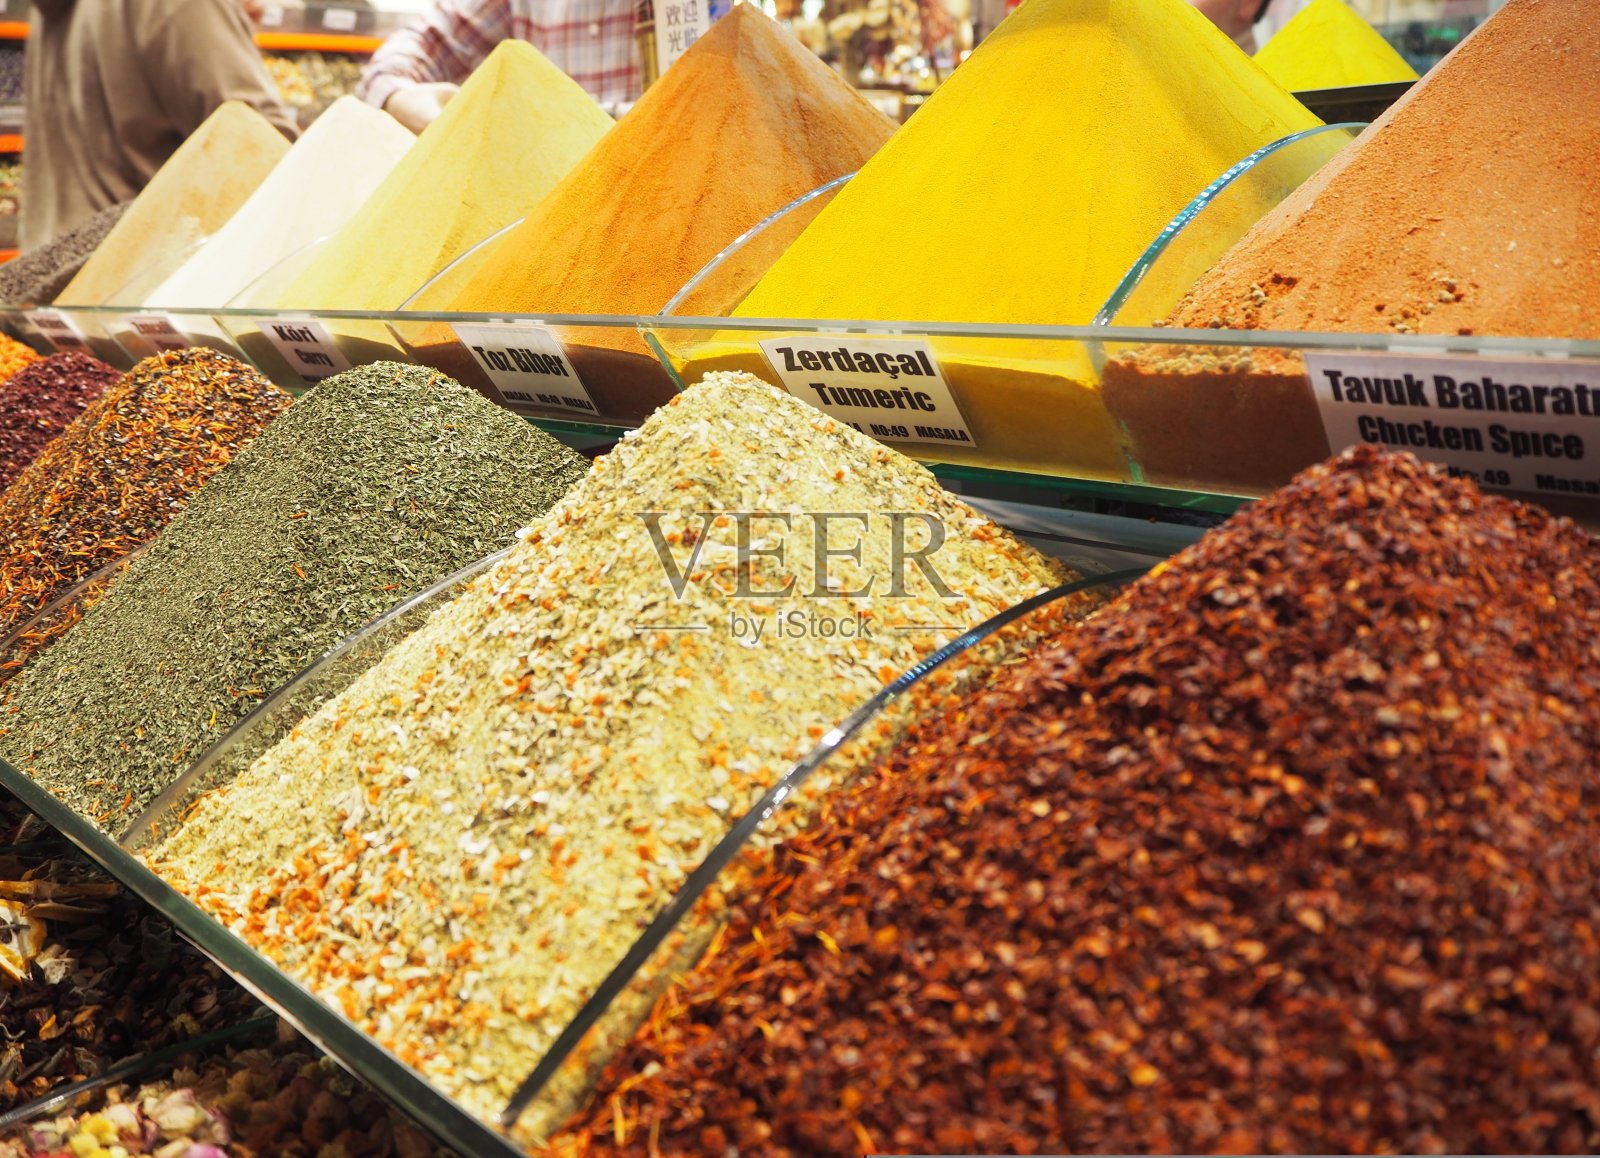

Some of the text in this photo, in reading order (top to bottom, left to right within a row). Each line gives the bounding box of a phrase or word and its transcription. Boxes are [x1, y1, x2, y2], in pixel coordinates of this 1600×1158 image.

[666, 0, 698, 26] 欢迎
[272, 324, 319, 343] Köri
[472, 346, 569, 377] Toz Biber
[776, 347, 937, 379] Zerdaçal
[809, 383, 936, 412] Tumeric
[1323, 369, 1430, 408] Tavuk
[869, 423, 910, 438] NO:49
[914, 425, 970, 442] MASALA
[1484, 469, 1511, 486] 49
